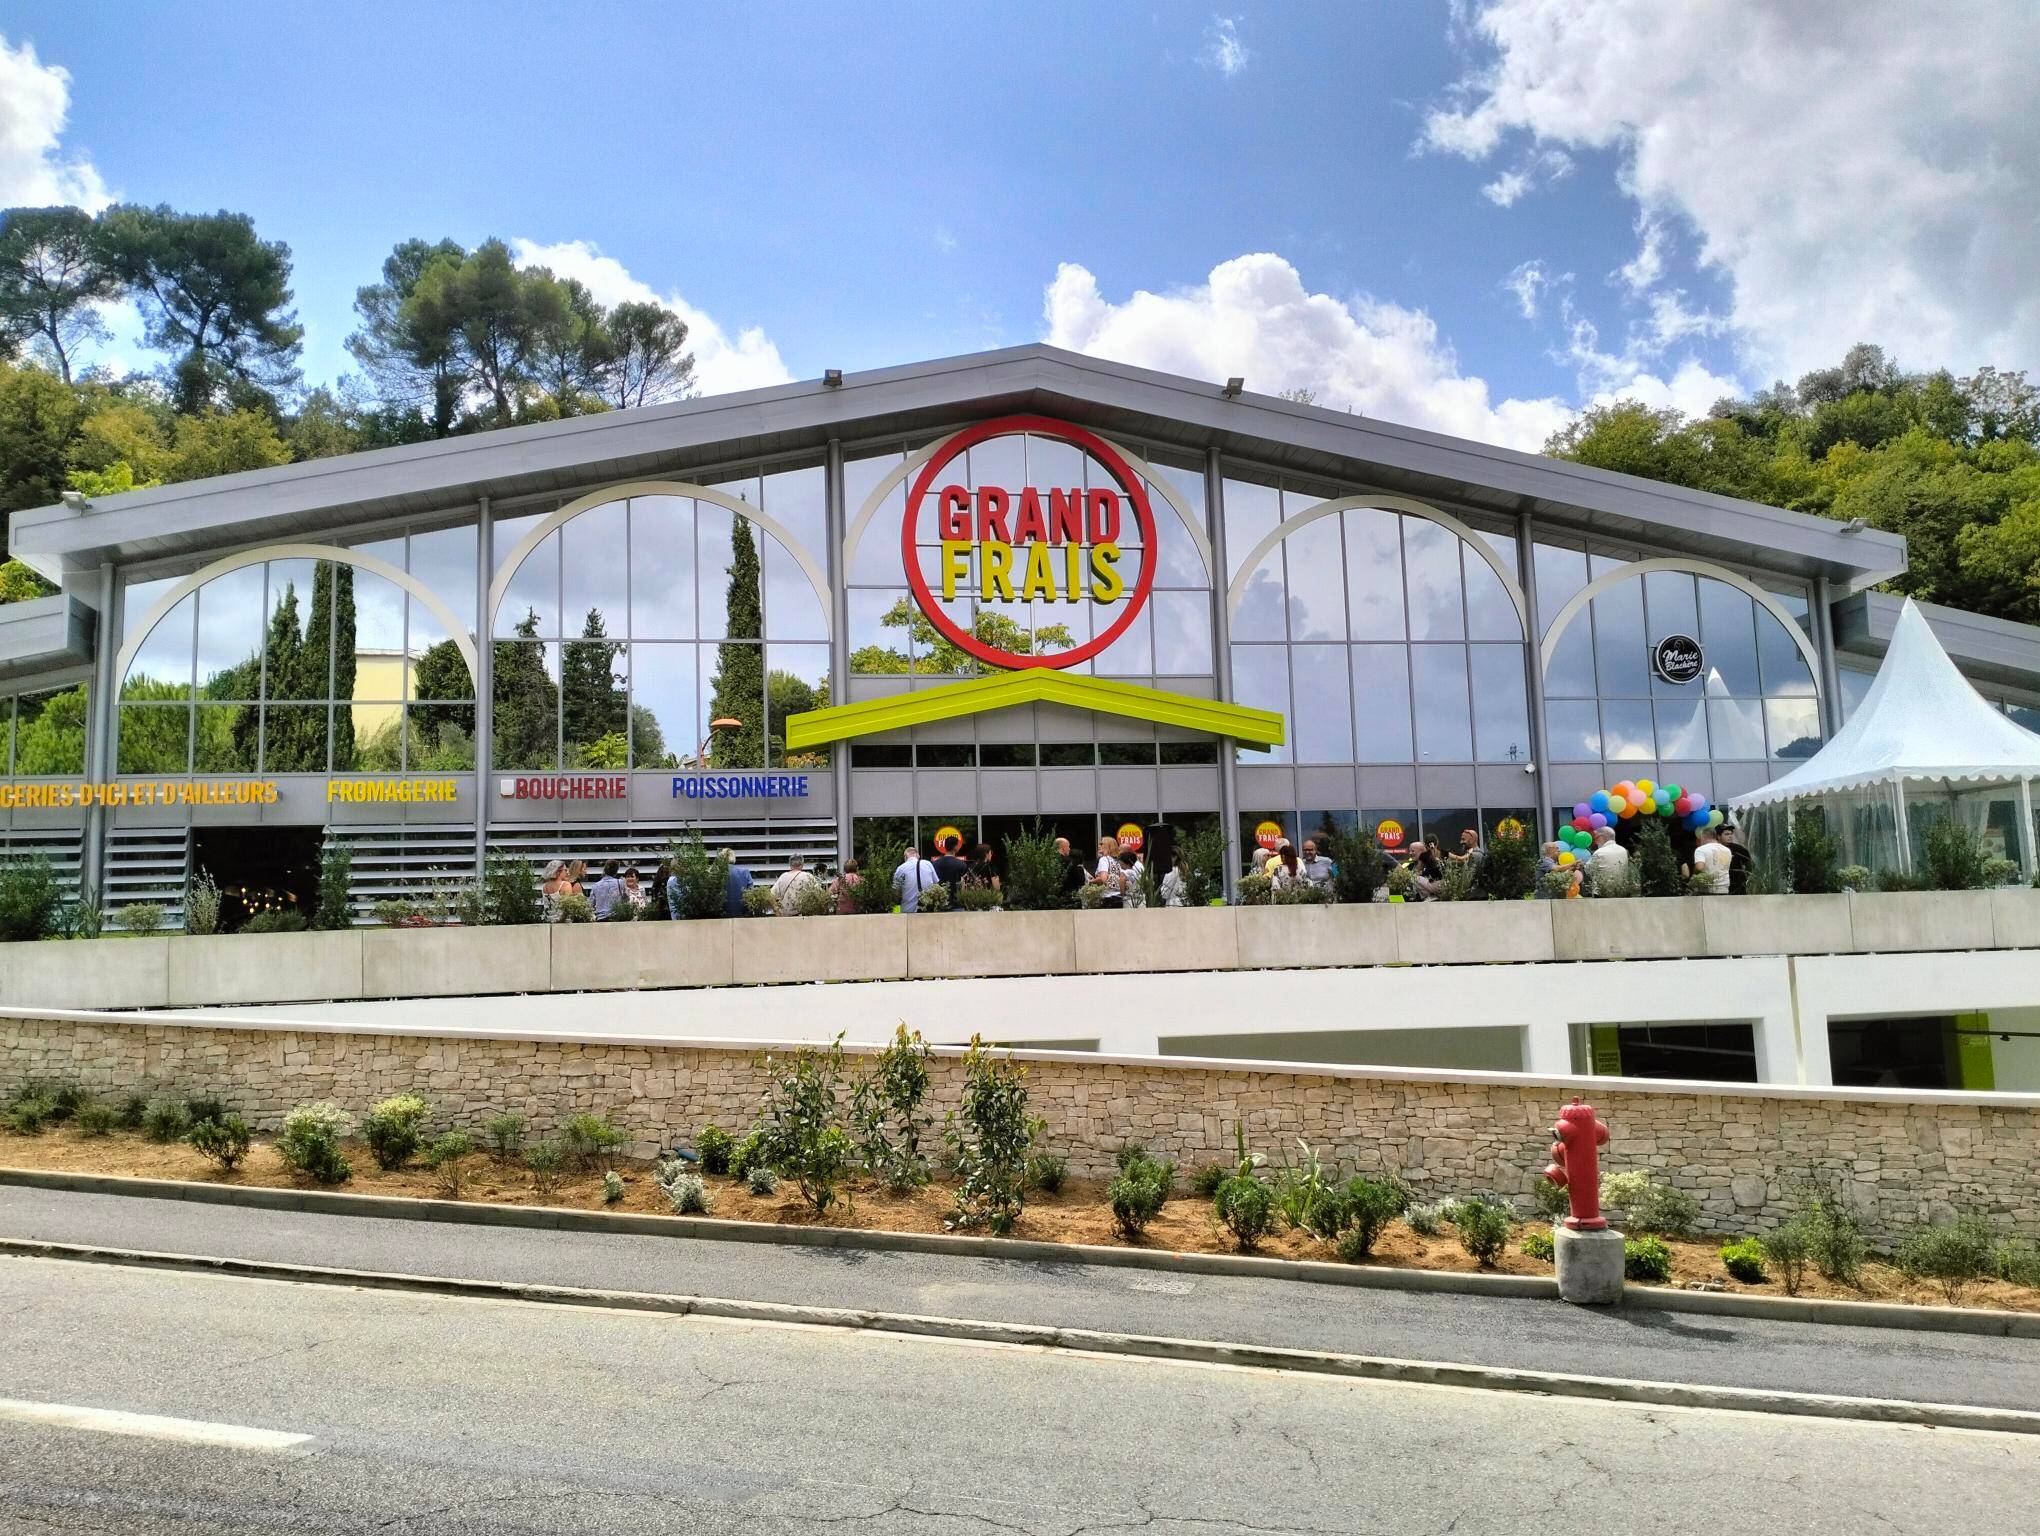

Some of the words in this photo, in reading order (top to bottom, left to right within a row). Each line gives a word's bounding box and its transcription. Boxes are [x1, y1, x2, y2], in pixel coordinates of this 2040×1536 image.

[938, 485, 1121, 546] GRAND
[942, 540, 1125, 605] FRAIS
[1662, 649, 1699, 662] Marie
[79, 782, 129, 807] D'ICI
[133, 782, 158, 806] ET
[161, 781, 278, 806] D'AILLEURS
[327, 779, 458, 803] FROMAGERIE
[515, 777, 627, 800] BOUCHERIE
[672, 775, 809, 799] POISSONNERIE
[1120, 836, 1141, 845] FRAIS
[1258, 834, 1280, 842] FRAIS
[1380, 832, 1400, 840] FRAIS
